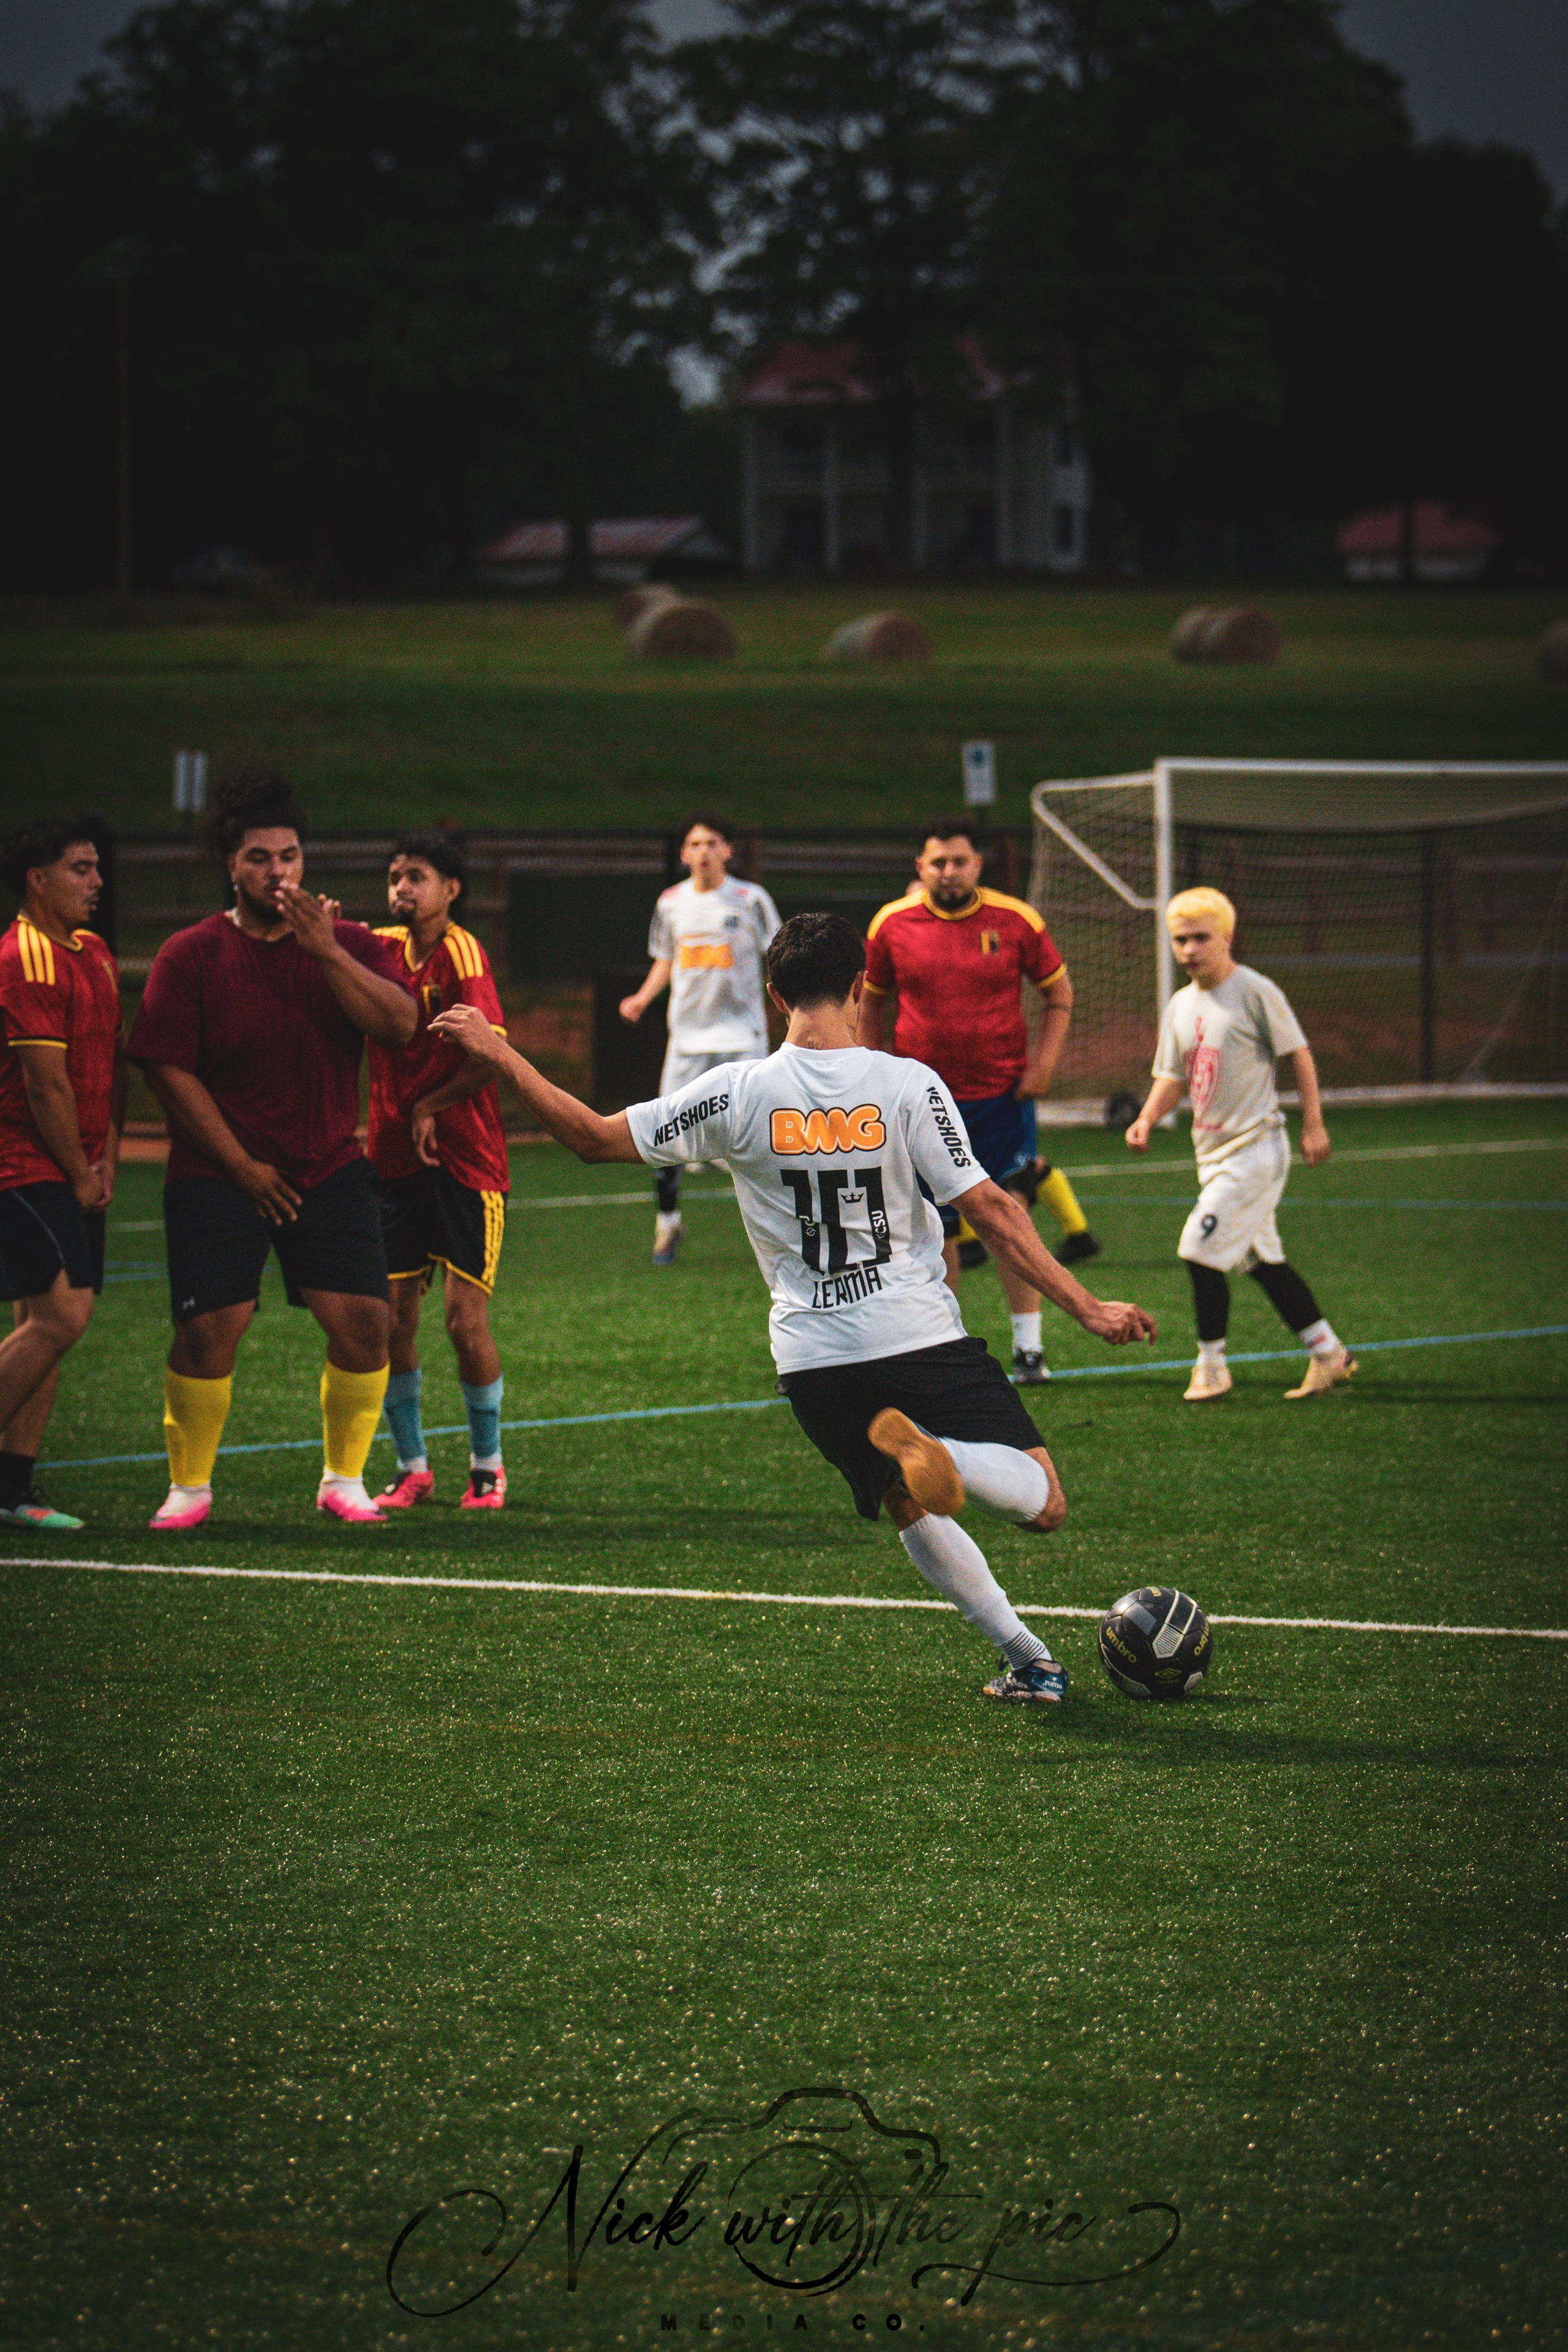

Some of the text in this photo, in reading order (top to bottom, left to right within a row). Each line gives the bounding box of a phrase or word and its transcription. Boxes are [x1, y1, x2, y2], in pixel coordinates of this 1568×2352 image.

[654, 1094, 729, 1147] NETSHOES
[769, 1104, 886, 1156] BMG
[1201, 1213, 1217, 1240] 9
[812, 1267, 883, 1309] LERMA
[1106, 1626, 1137, 1664] umbro
